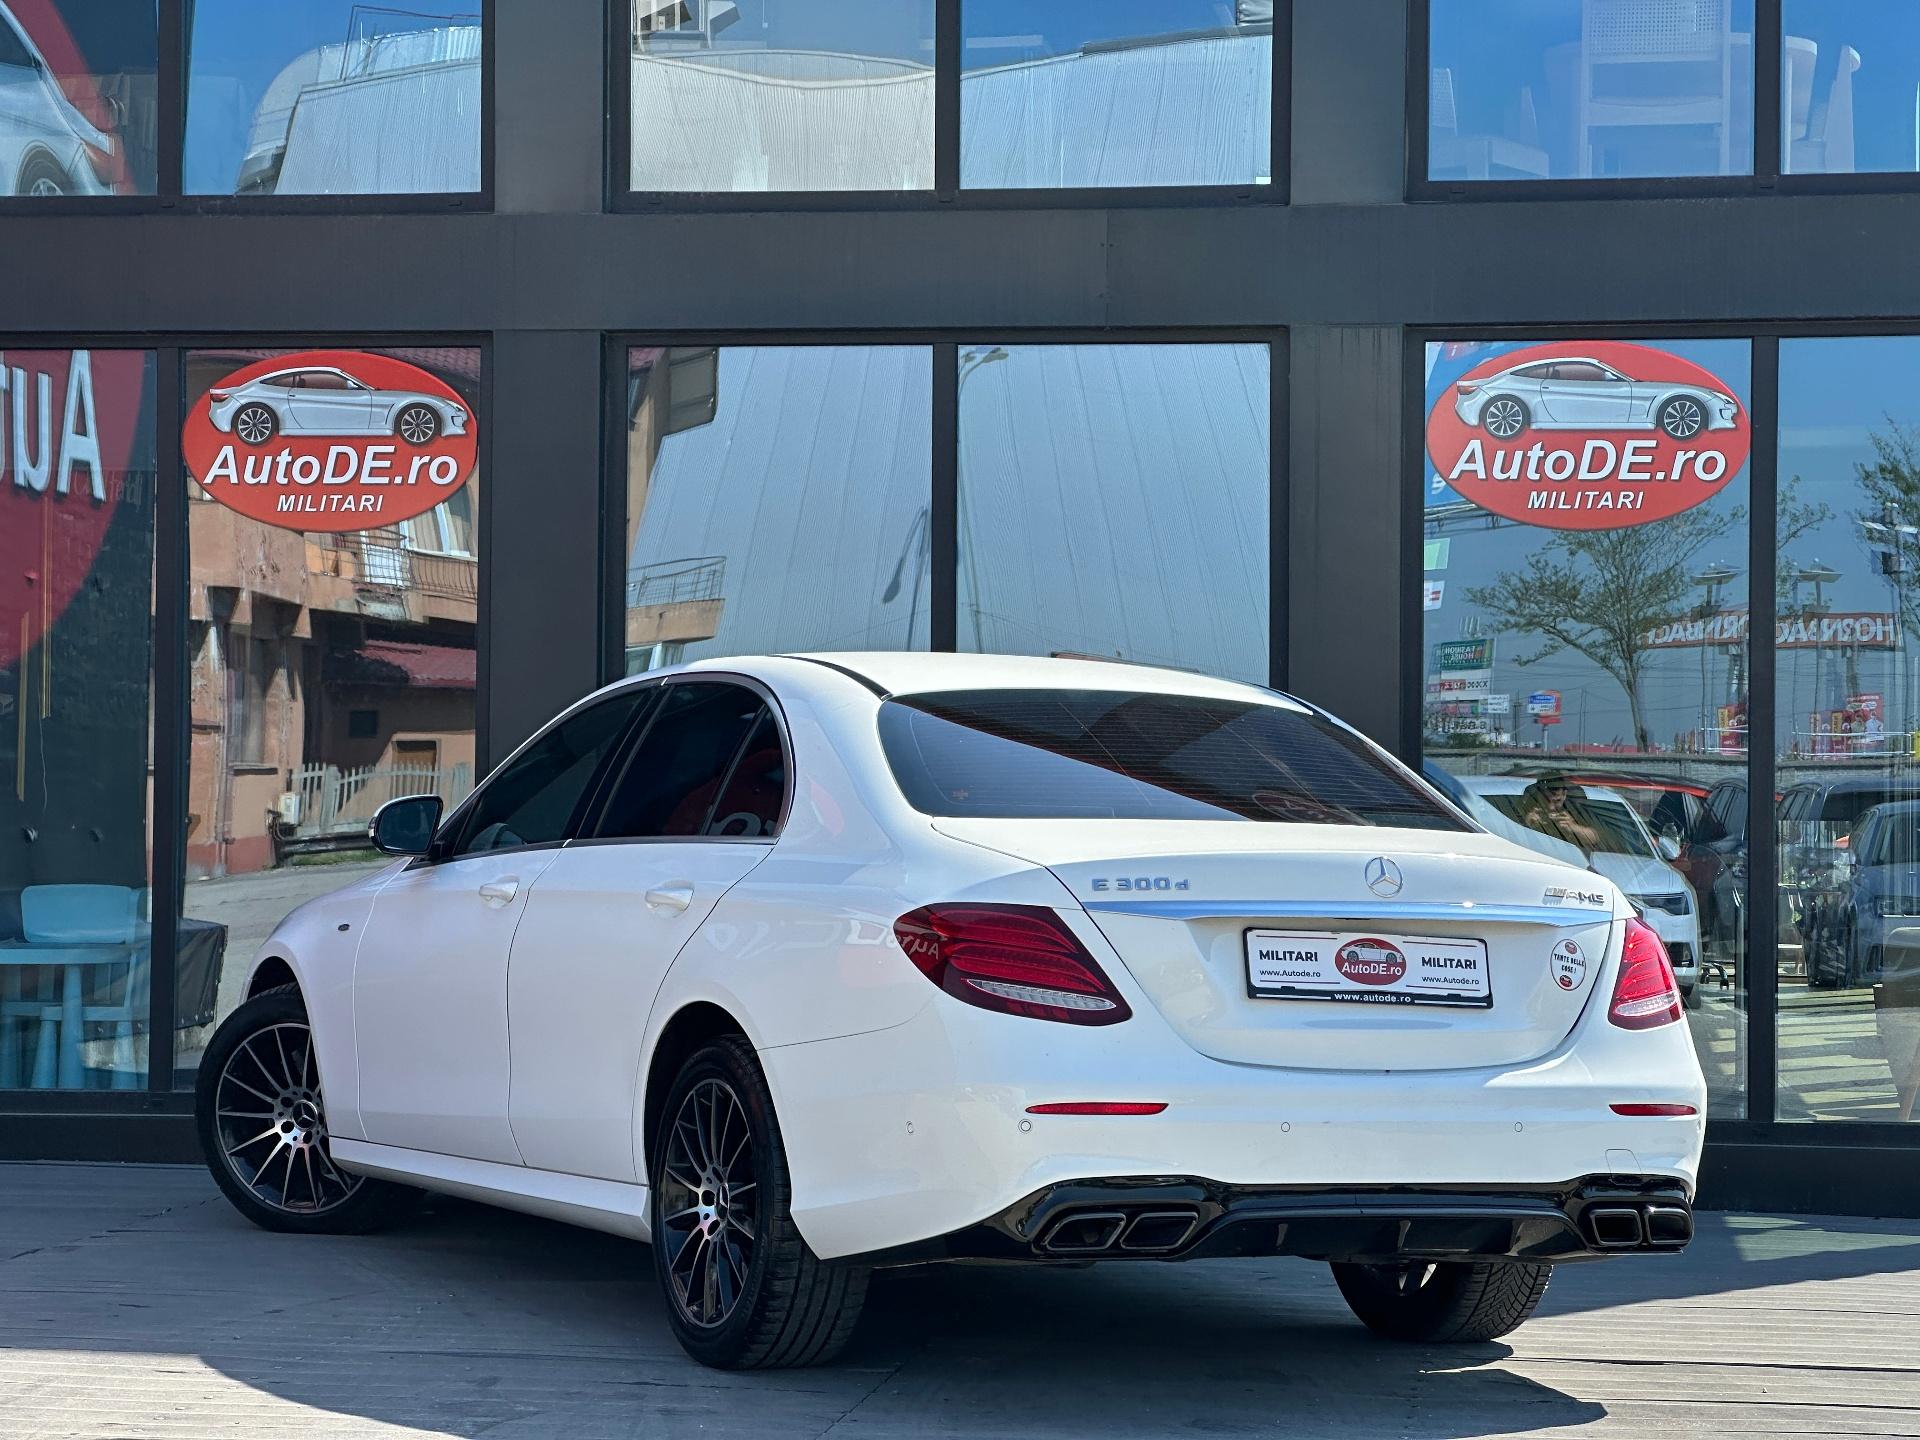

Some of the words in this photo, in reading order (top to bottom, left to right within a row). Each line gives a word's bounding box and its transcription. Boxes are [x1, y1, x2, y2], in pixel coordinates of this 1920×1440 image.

[203, 445, 459, 485] AutoDE.ro
[1448, 438, 1727, 482] AutoDE.ro
[276, 494, 384, 513] MILITARI
[1527, 490, 1645, 511] MILITARI
[1092, 878, 1110, 892] E
[1258, 950, 1318, 962] MILITARI
[1421, 956, 1477, 970] MILITARI
[1259, 969, 1321, 978] www.Autode.ro
[1341, 962, 1402, 976] AutoDE.ro
[1421, 976, 1480, 985] www.Autode.ro
[1334, 992, 1411, 1003] www.autode.ro
